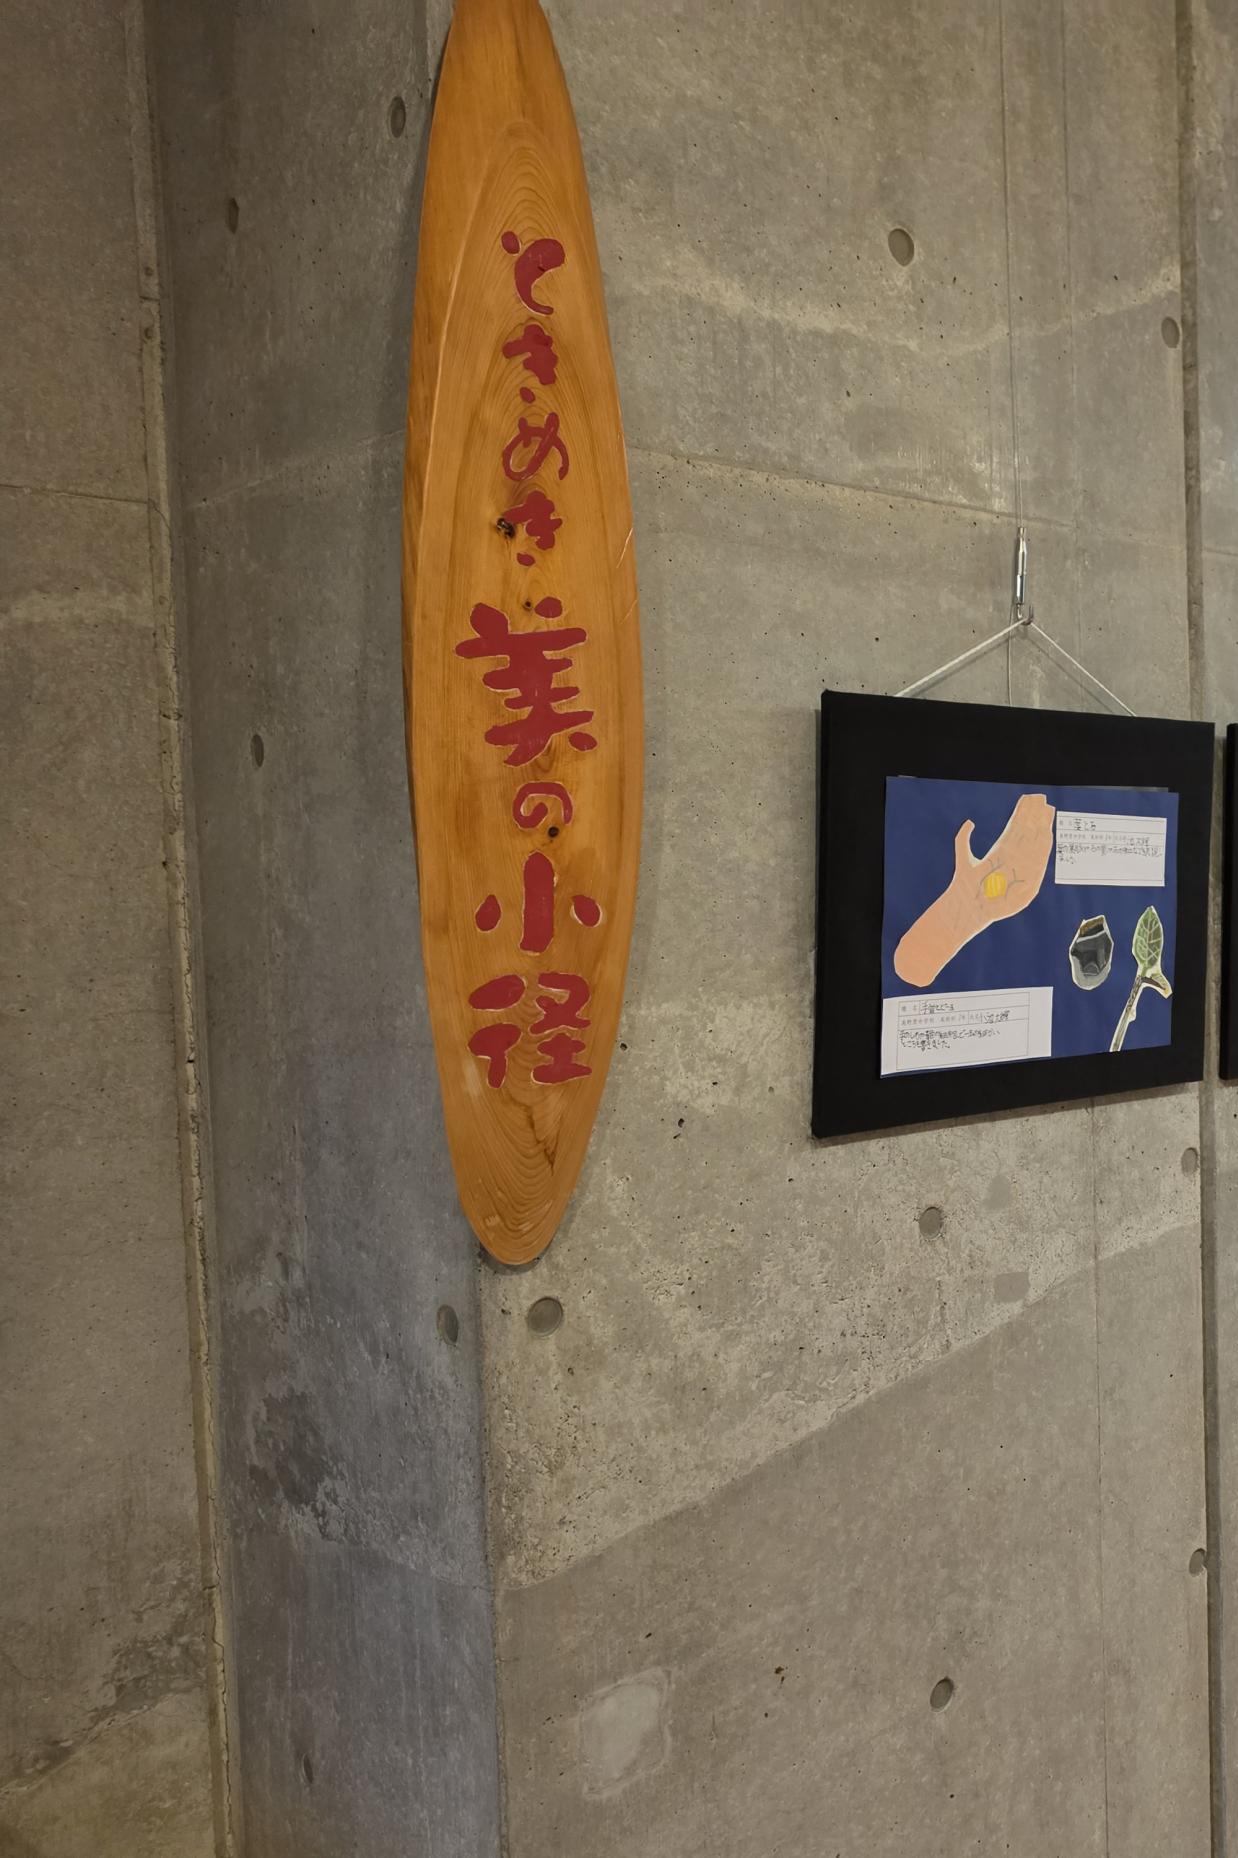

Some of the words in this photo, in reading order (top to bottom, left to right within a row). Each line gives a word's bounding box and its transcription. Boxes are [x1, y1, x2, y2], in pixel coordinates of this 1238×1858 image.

[455, 231, 601, 1089] ときめき美の小径
